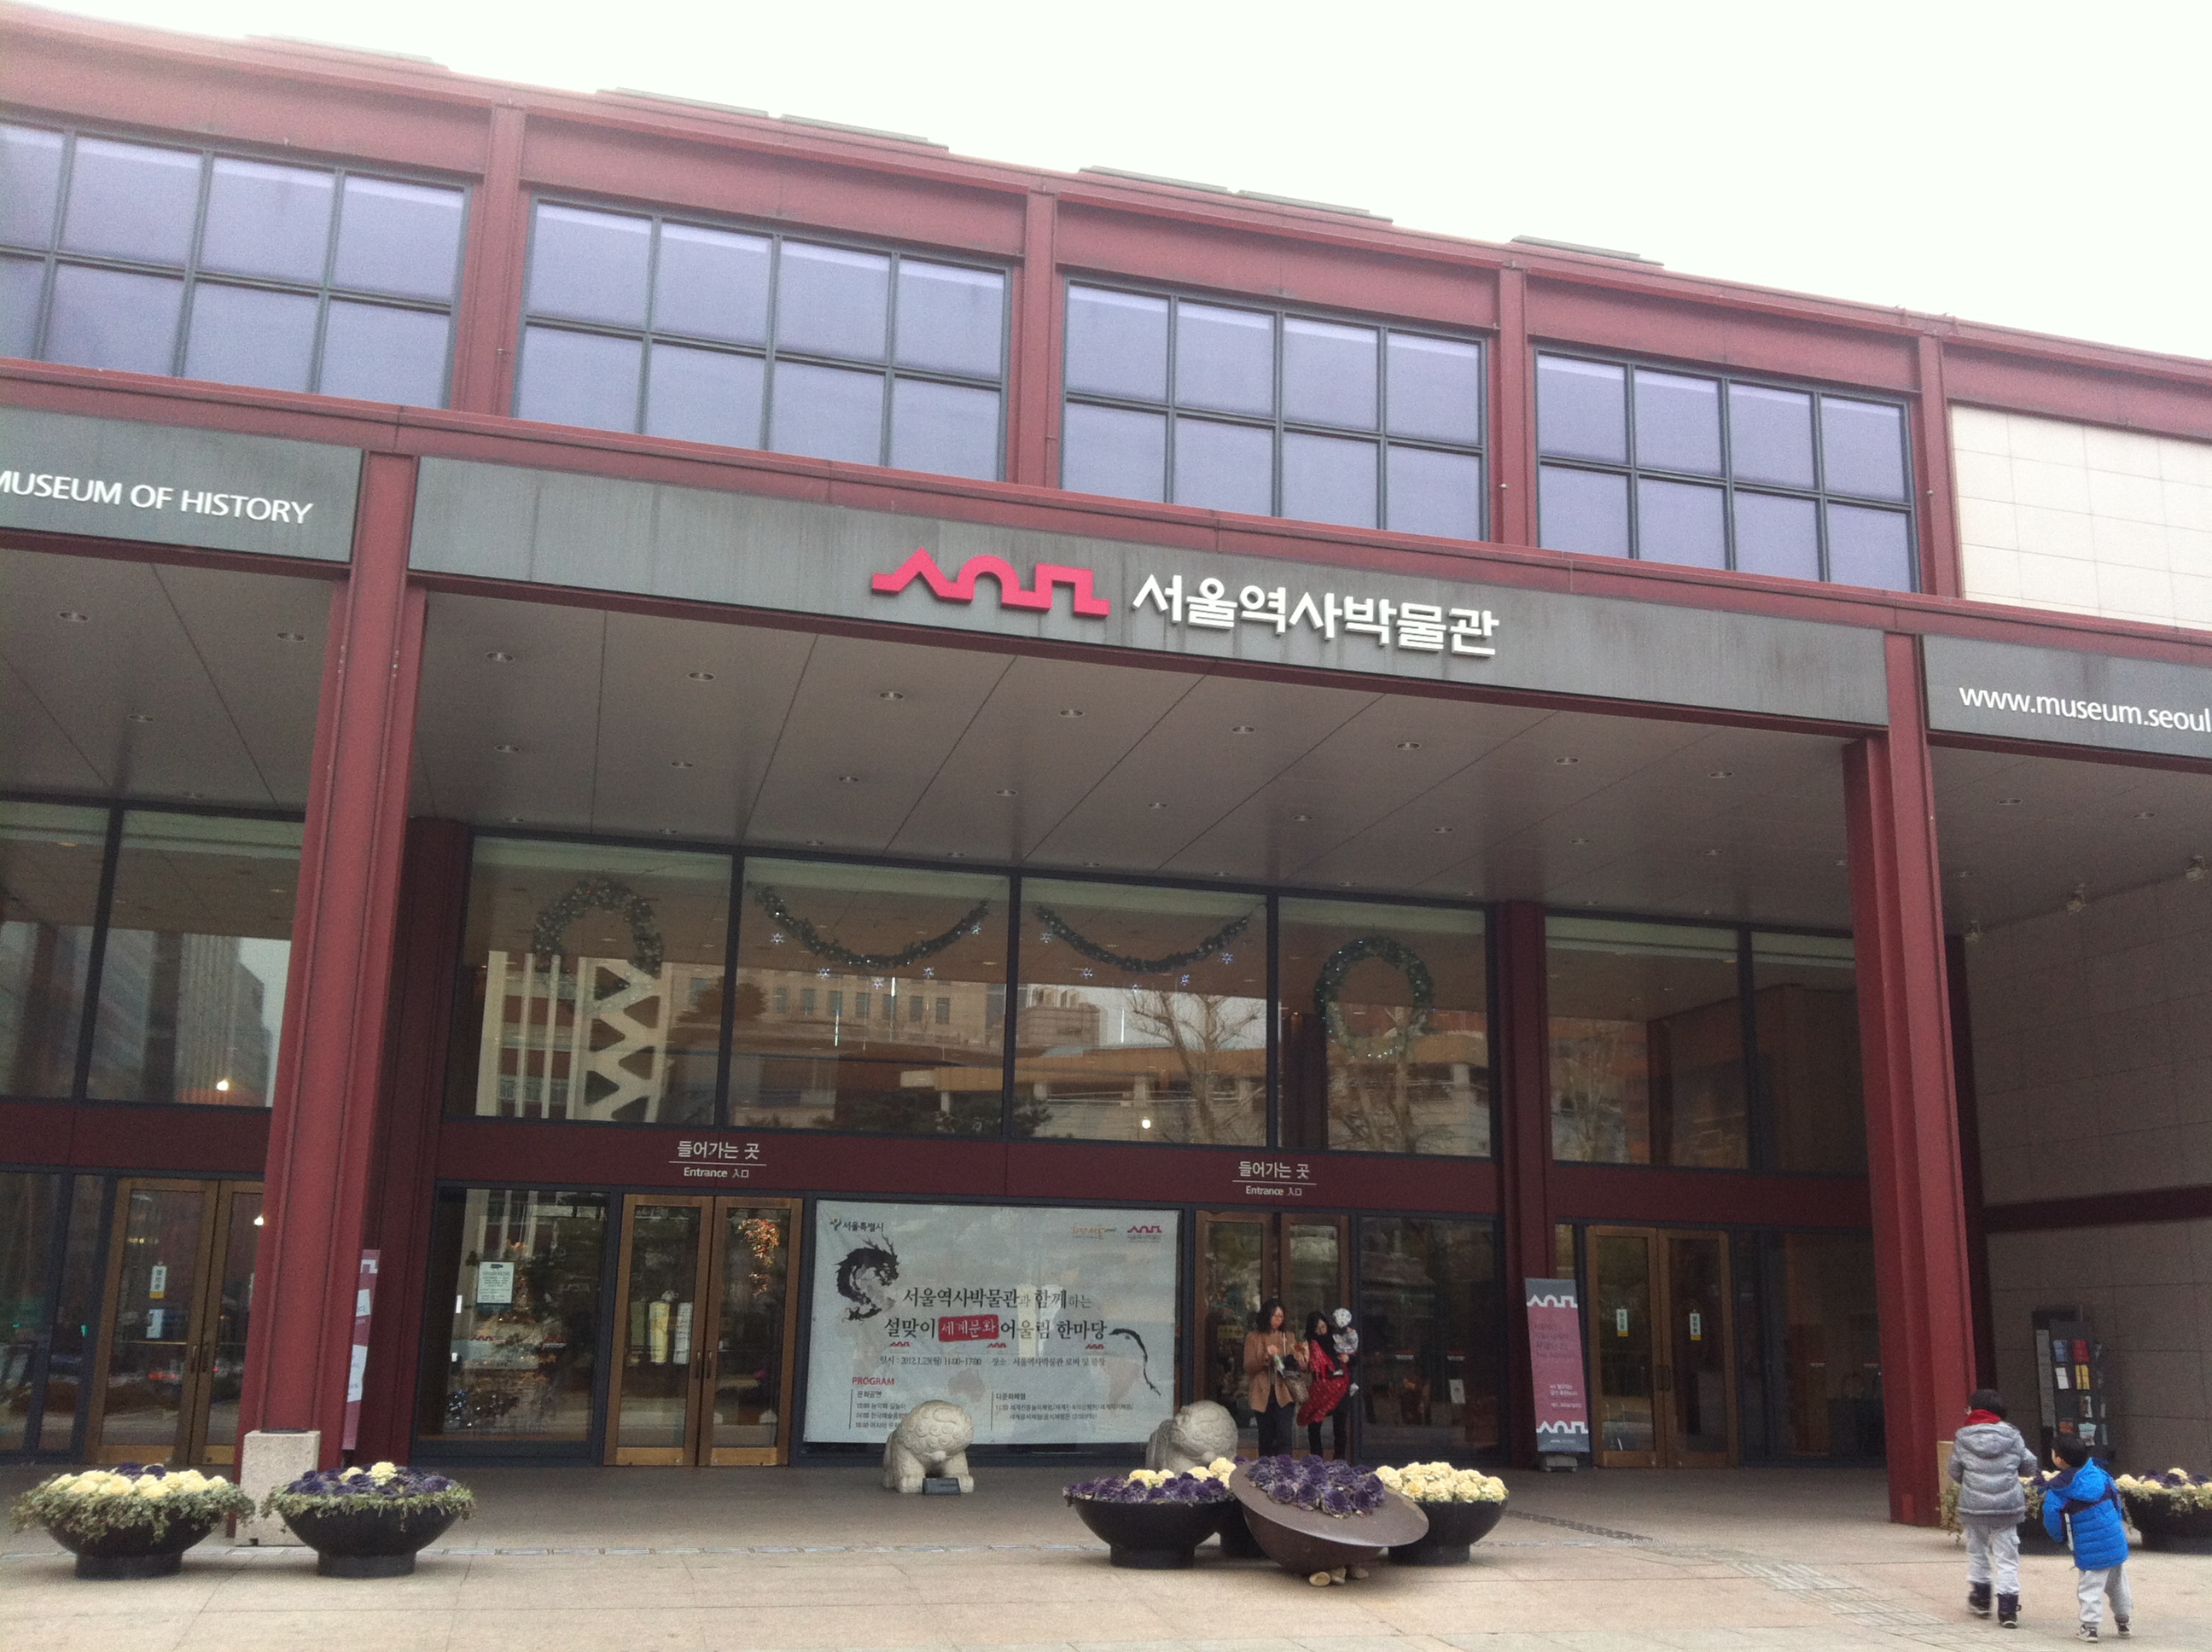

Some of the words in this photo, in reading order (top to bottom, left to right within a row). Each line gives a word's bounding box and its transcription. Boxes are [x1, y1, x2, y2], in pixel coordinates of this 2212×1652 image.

[130, 484, 174, 510] OF
[180, 490, 314, 525] HISTORY
[1131, 573, 1499, 659] 서울역사박물관
[1959, 687, 2212, 732] www.museum.seoul
[678, 1141, 739, 1159] 들어가는
[744, 1143, 760, 1160] 곳
[684, 1166, 728, 1178] Entrance
[732, 1169, 749, 1178] 入口
[1238, 1160, 1292, 1178] 들어가는
[1295, 1163, 1310, 1179] 곳
[1245, 1185, 1284, 1195] Entrance
[1287, 1187, 1302, 1196] 入口
[842, 1221, 884, 1232] 서울특별시
[884, 1318, 936, 1339] 설맞이
[941, 1319, 996, 1338] 세계문화
[1000, 1318, 1050, 1340] 어울림
[1057, 1319, 1108, 1341] 한마당
[853, 1376, 895, 1386] PROGRAM
